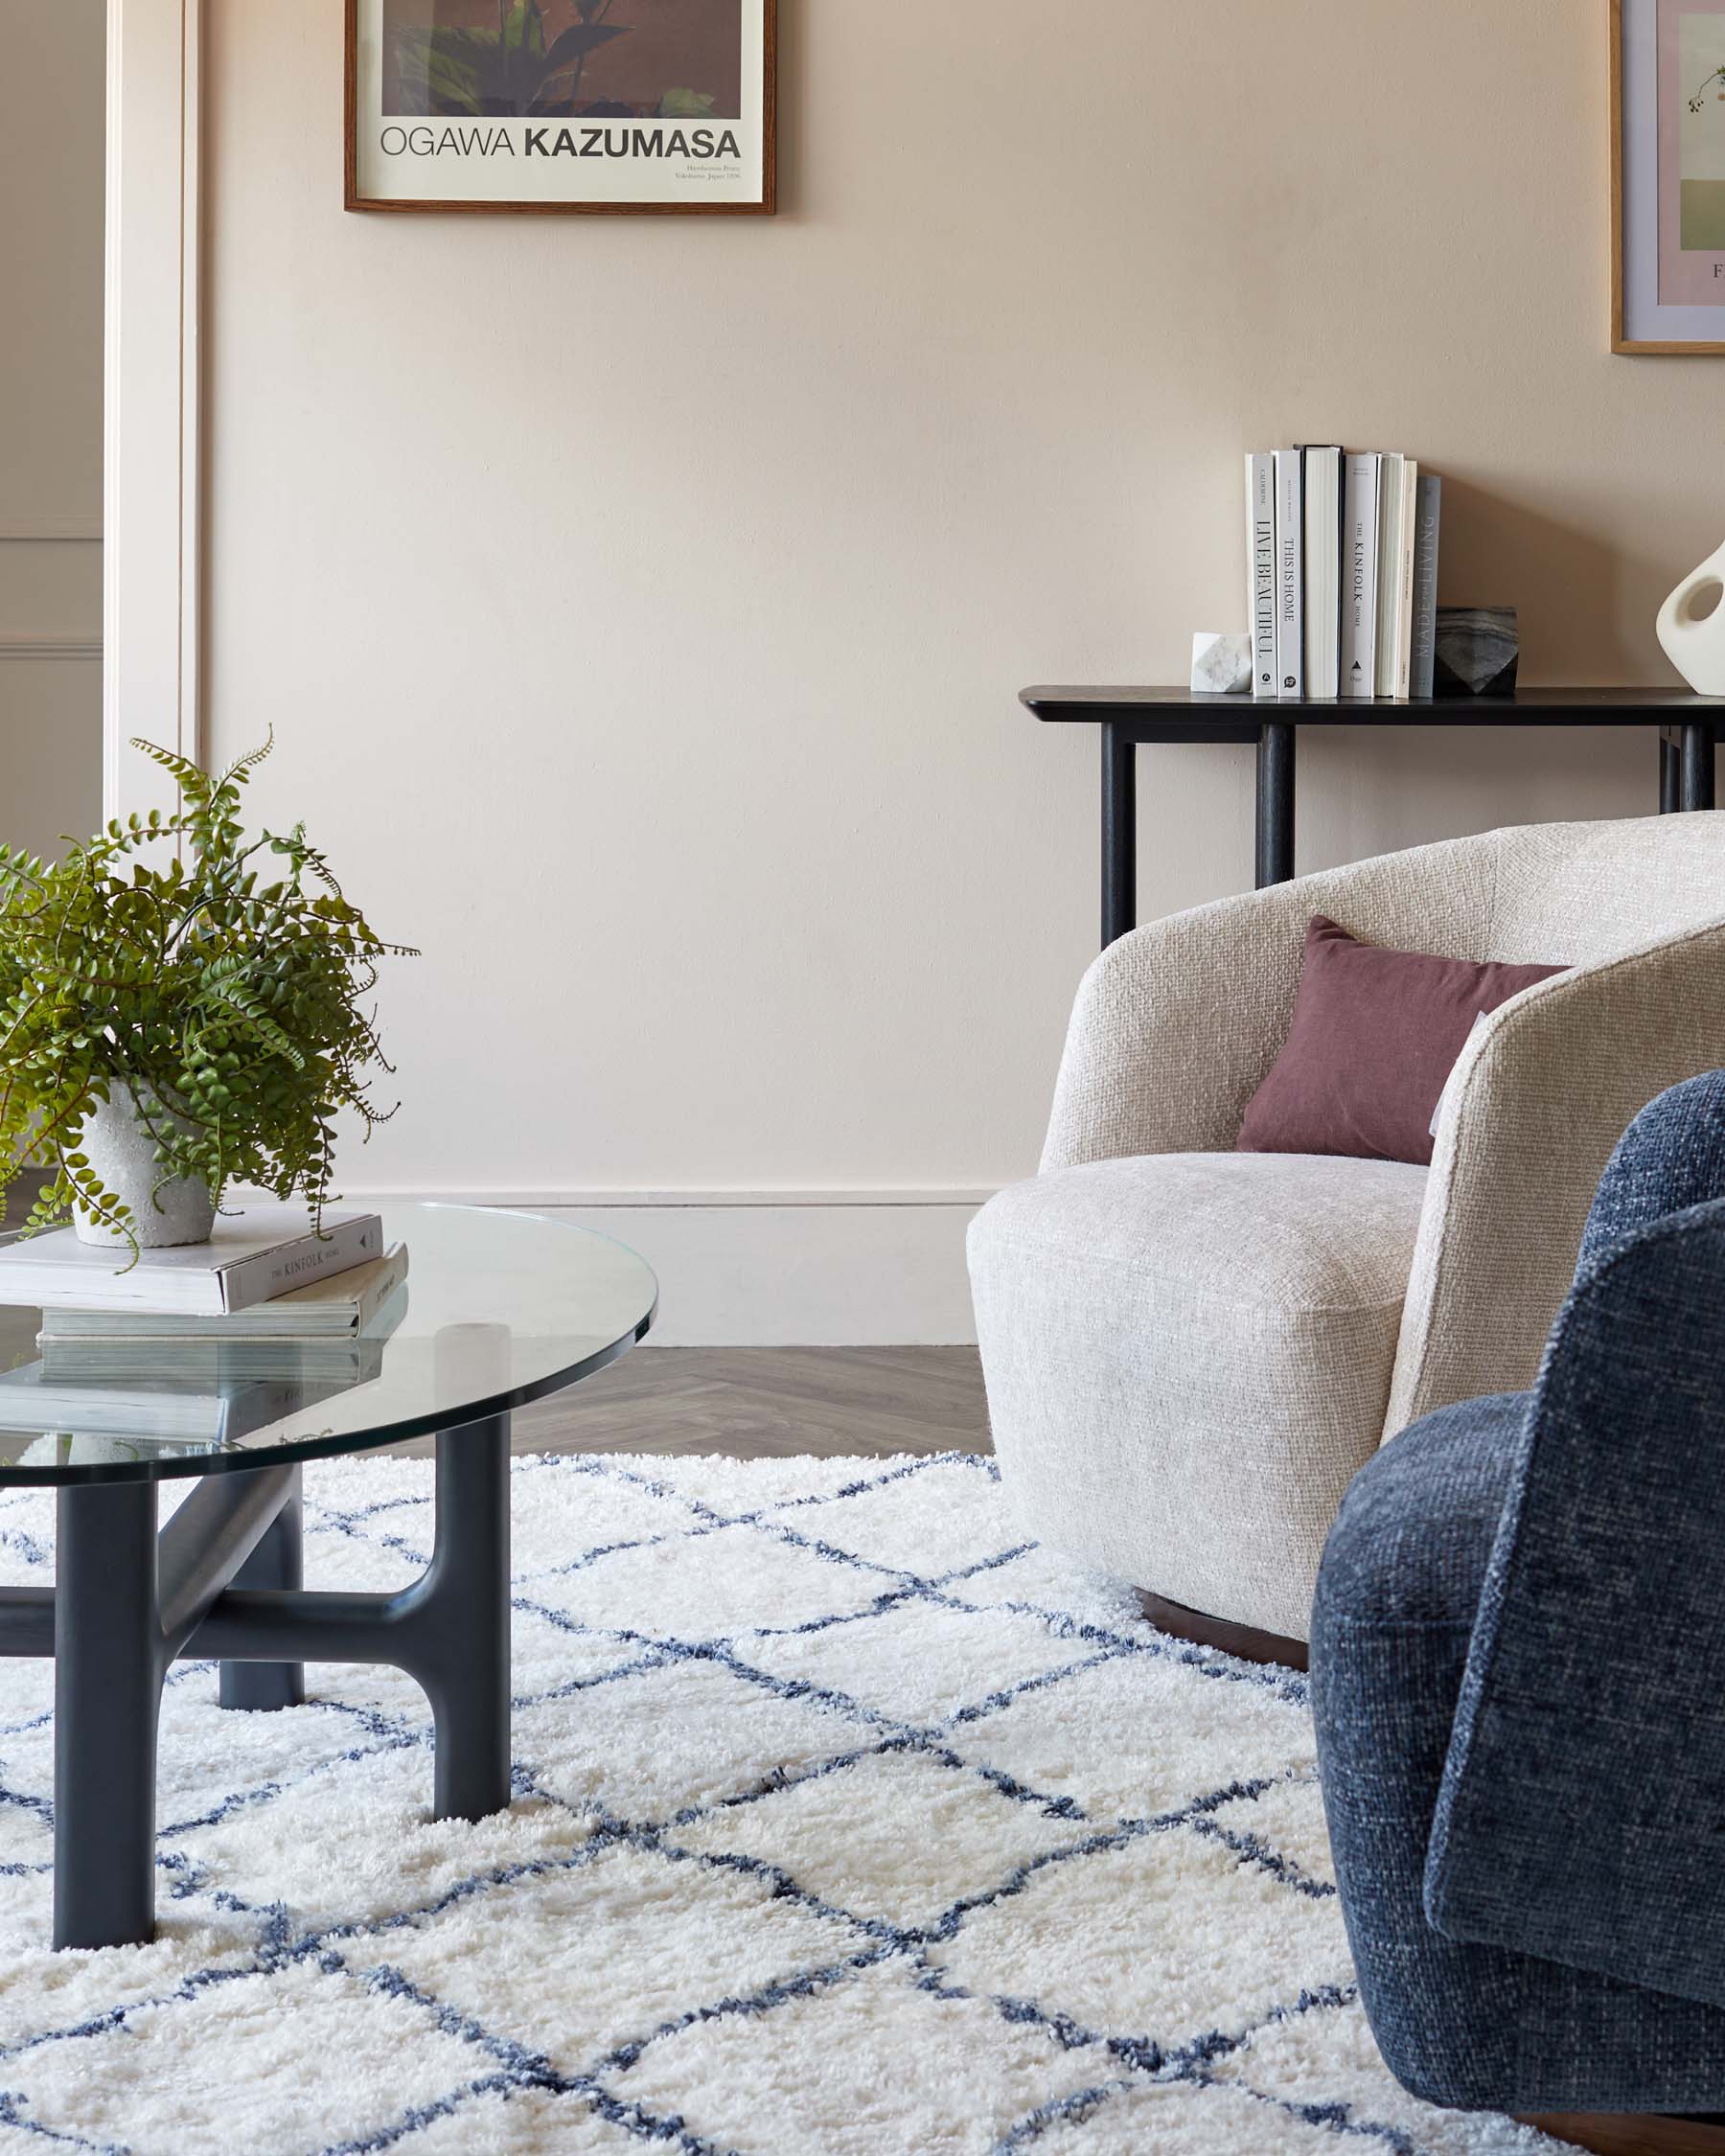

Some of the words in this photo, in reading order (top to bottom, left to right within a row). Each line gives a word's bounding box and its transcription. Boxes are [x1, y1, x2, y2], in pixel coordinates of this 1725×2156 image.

[380, 126, 516, 156] OGAWA
[524, 127, 742, 158] KAZUMASA
[1256, 520, 1272, 559] LIVE
[1284, 538, 1295, 567] THIS
[1418, 516, 1436, 583] LIVING
[1284, 570, 1295, 582] IS
[1354, 542, 1365, 602] KINFOLK
[1257, 563, 1273, 659] BEAUTIFUL
[1284, 584, 1295, 623] HOME
[1416, 604, 1431, 658] MADE
[285, 1251, 324, 1277] KINFOLK
